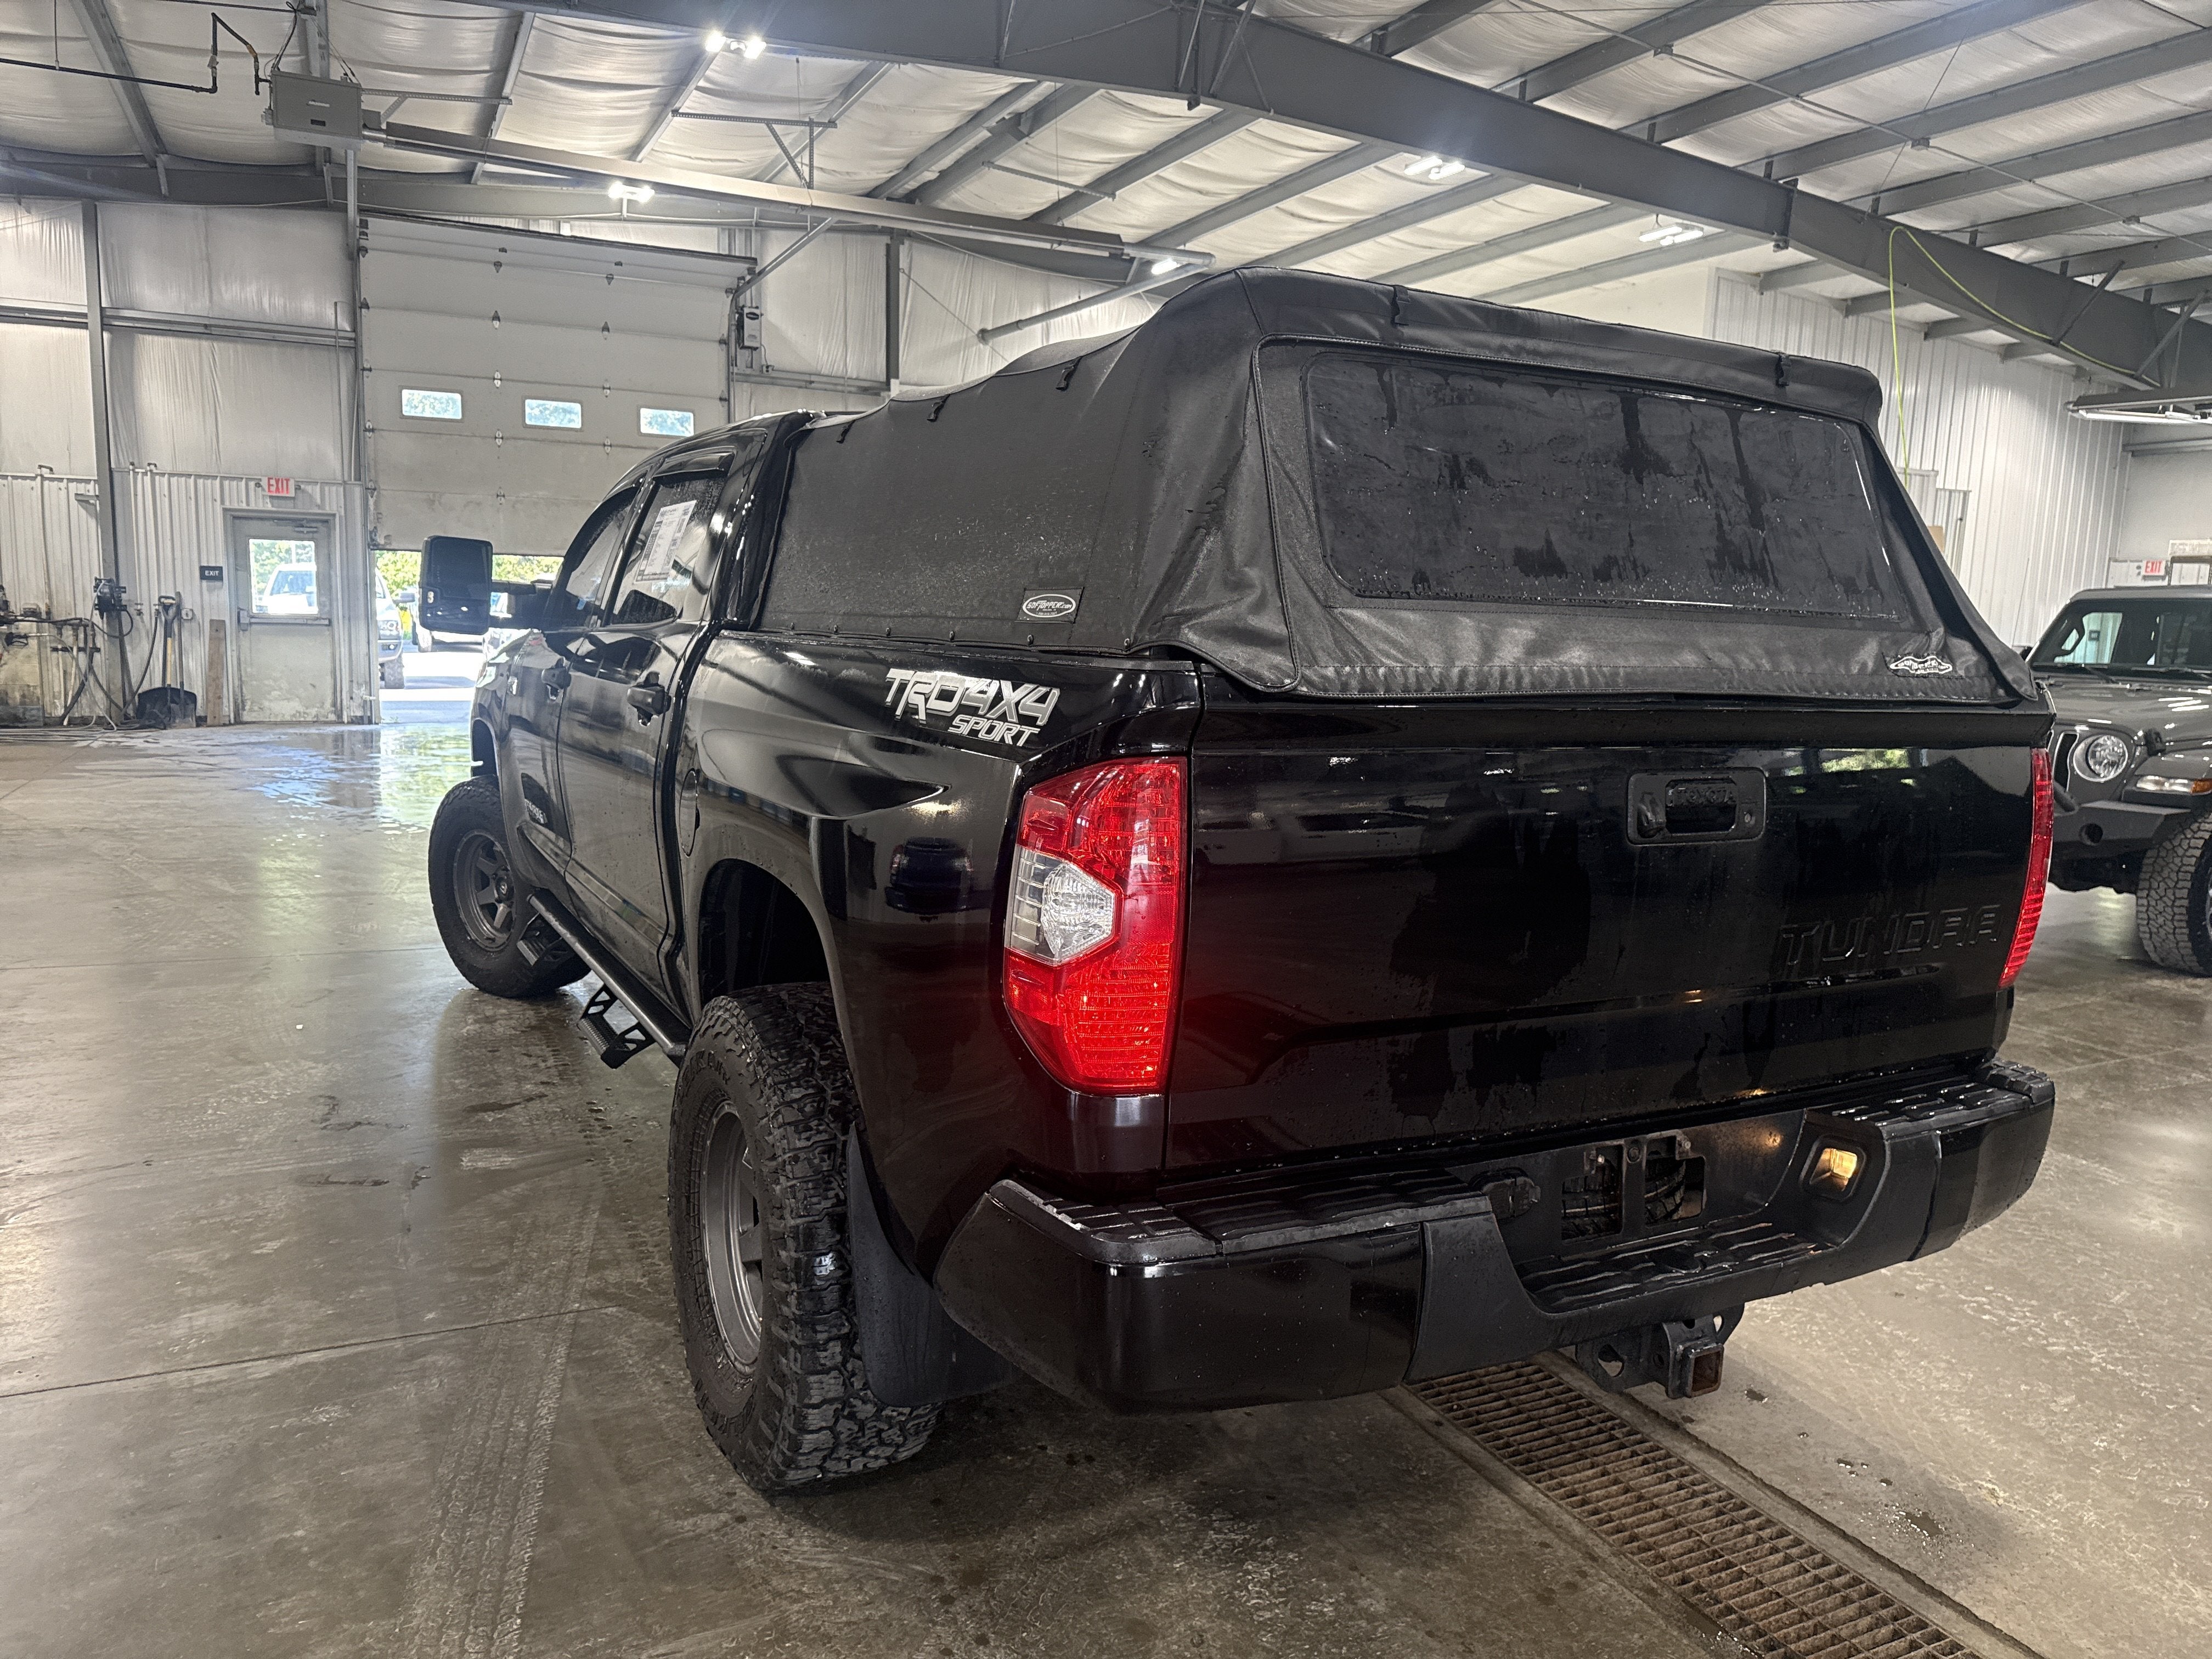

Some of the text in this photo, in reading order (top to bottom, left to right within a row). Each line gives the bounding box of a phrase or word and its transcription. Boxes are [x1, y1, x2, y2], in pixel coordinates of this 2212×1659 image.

[267, 477, 290, 494] EXIT
[2145, 561, 2163, 573] EXIT
[947, 714, 1041, 747] SPORT
[1780, 904, 2001, 966] TUNDRA
